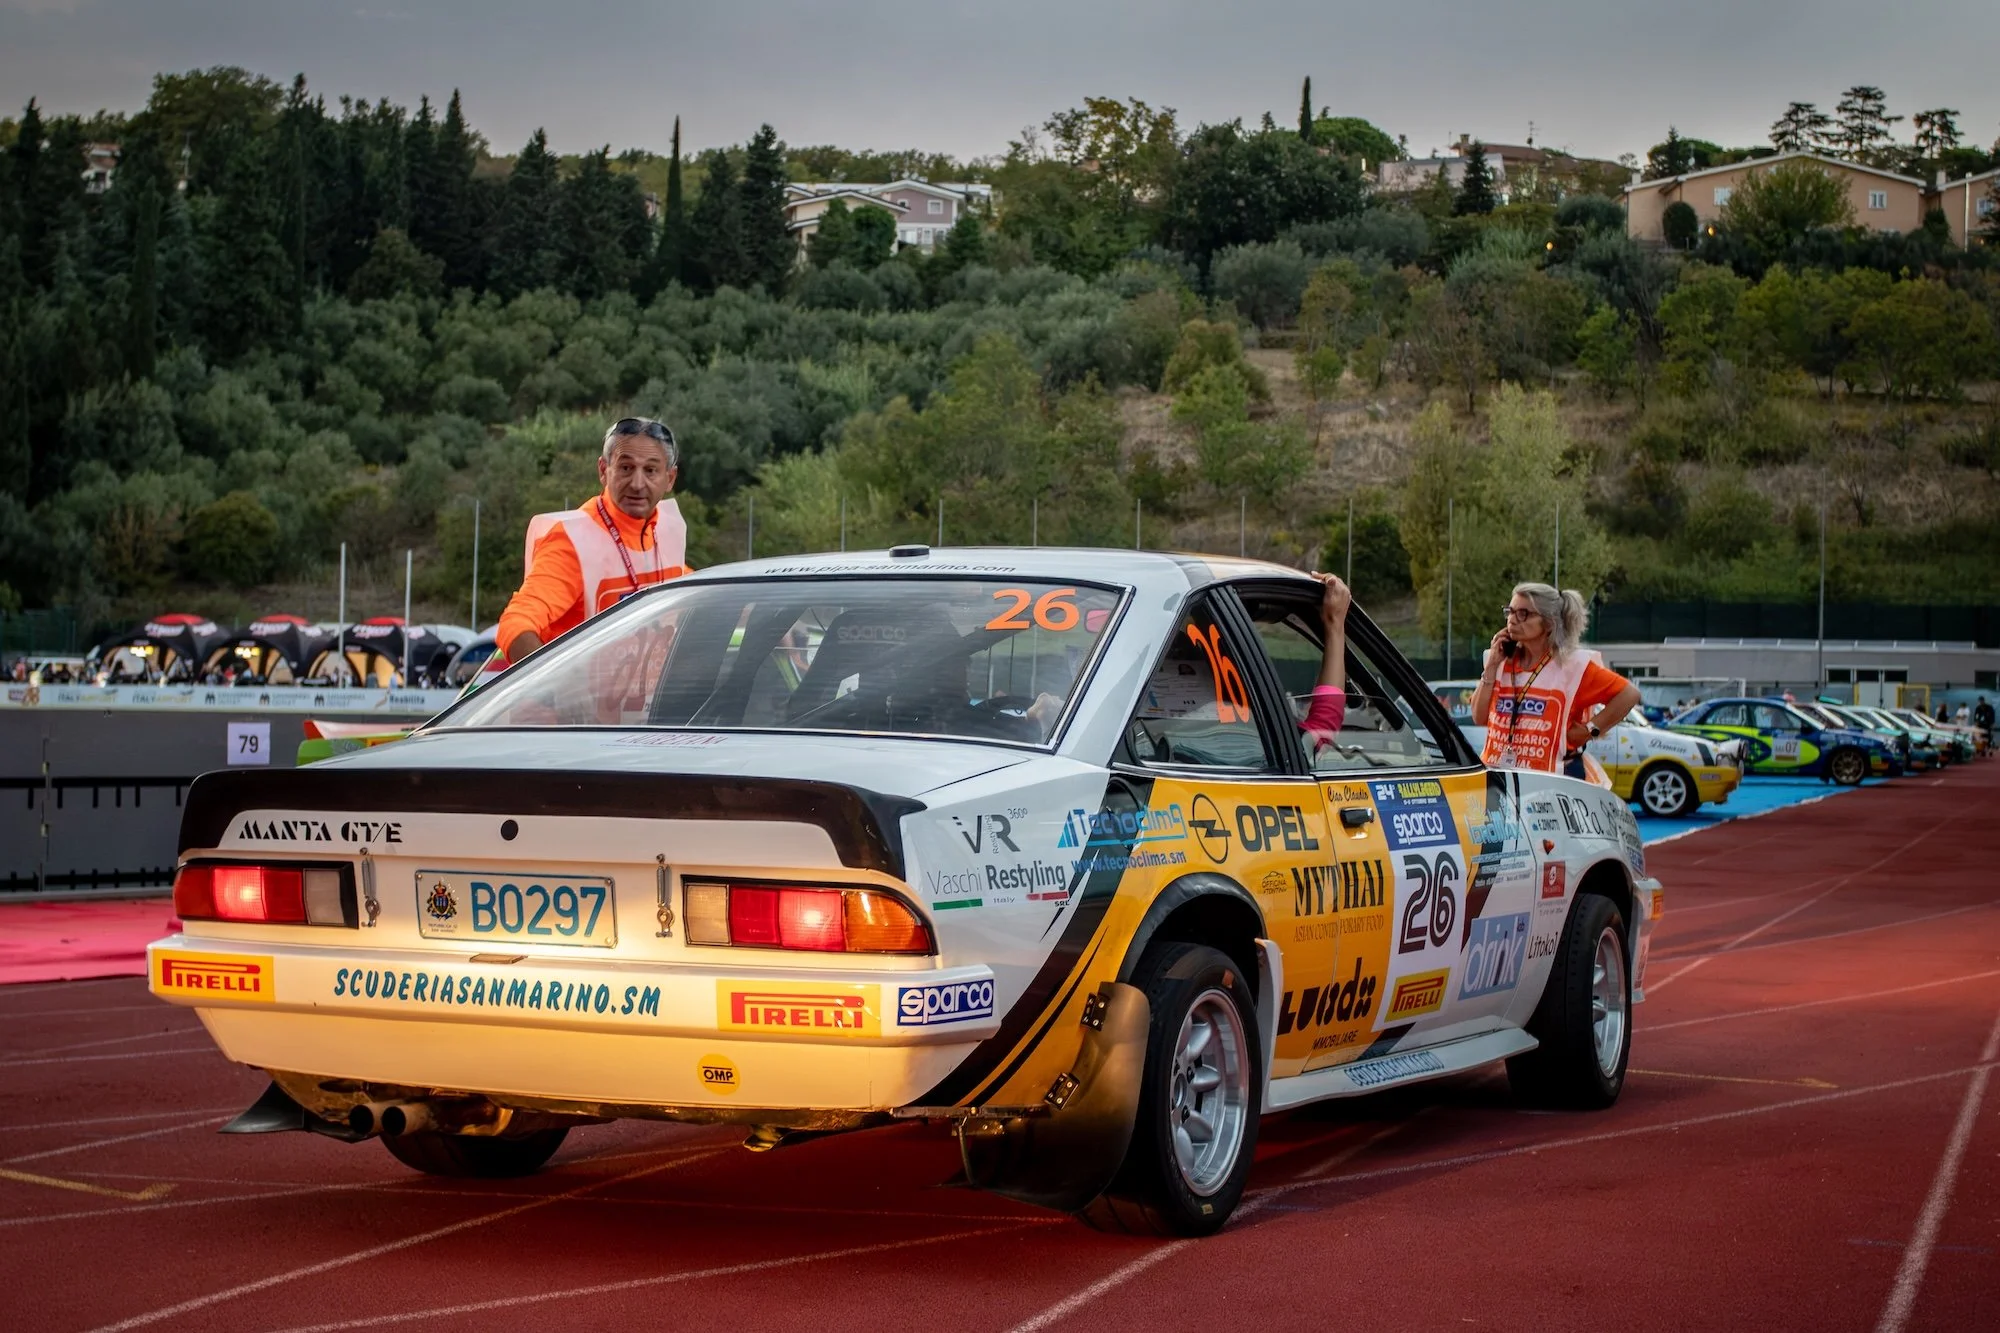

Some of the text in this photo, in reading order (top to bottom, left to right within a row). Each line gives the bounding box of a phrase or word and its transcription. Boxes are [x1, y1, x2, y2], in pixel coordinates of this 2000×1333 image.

[764, 562, 1016, 575] www.pipa-sanmarino.com
[985, 588, 1080, 631] 26
[1187, 624, 1249, 723] 26
[1497, 698, 1544, 713] sprco
[238, 735, 259, 753] 79
[1328, 785, 1369, 802] Ciao Claudio
[239, 820, 403, 843] MANTA GT/E
[1236, 805, 1319, 851] OPEL
[1393, 811, 1444, 845] sparco
[927, 860, 1067, 895] Vaschi Restyling
[470, 882, 607, 937] B0297
[1399, 851, 1459, 955] 26
[162, 958, 261, 993] PIRELLI
[334, 967, 661, 1017] SCUDERIASANMARINO.SM
[731, 992, 865, 1029] PIRELLI
[900, 982, 993, 1024] sparco
[1392, 976, 1445, 1013] PIRELLI
[703, 1068, 734, 1082] OMP
